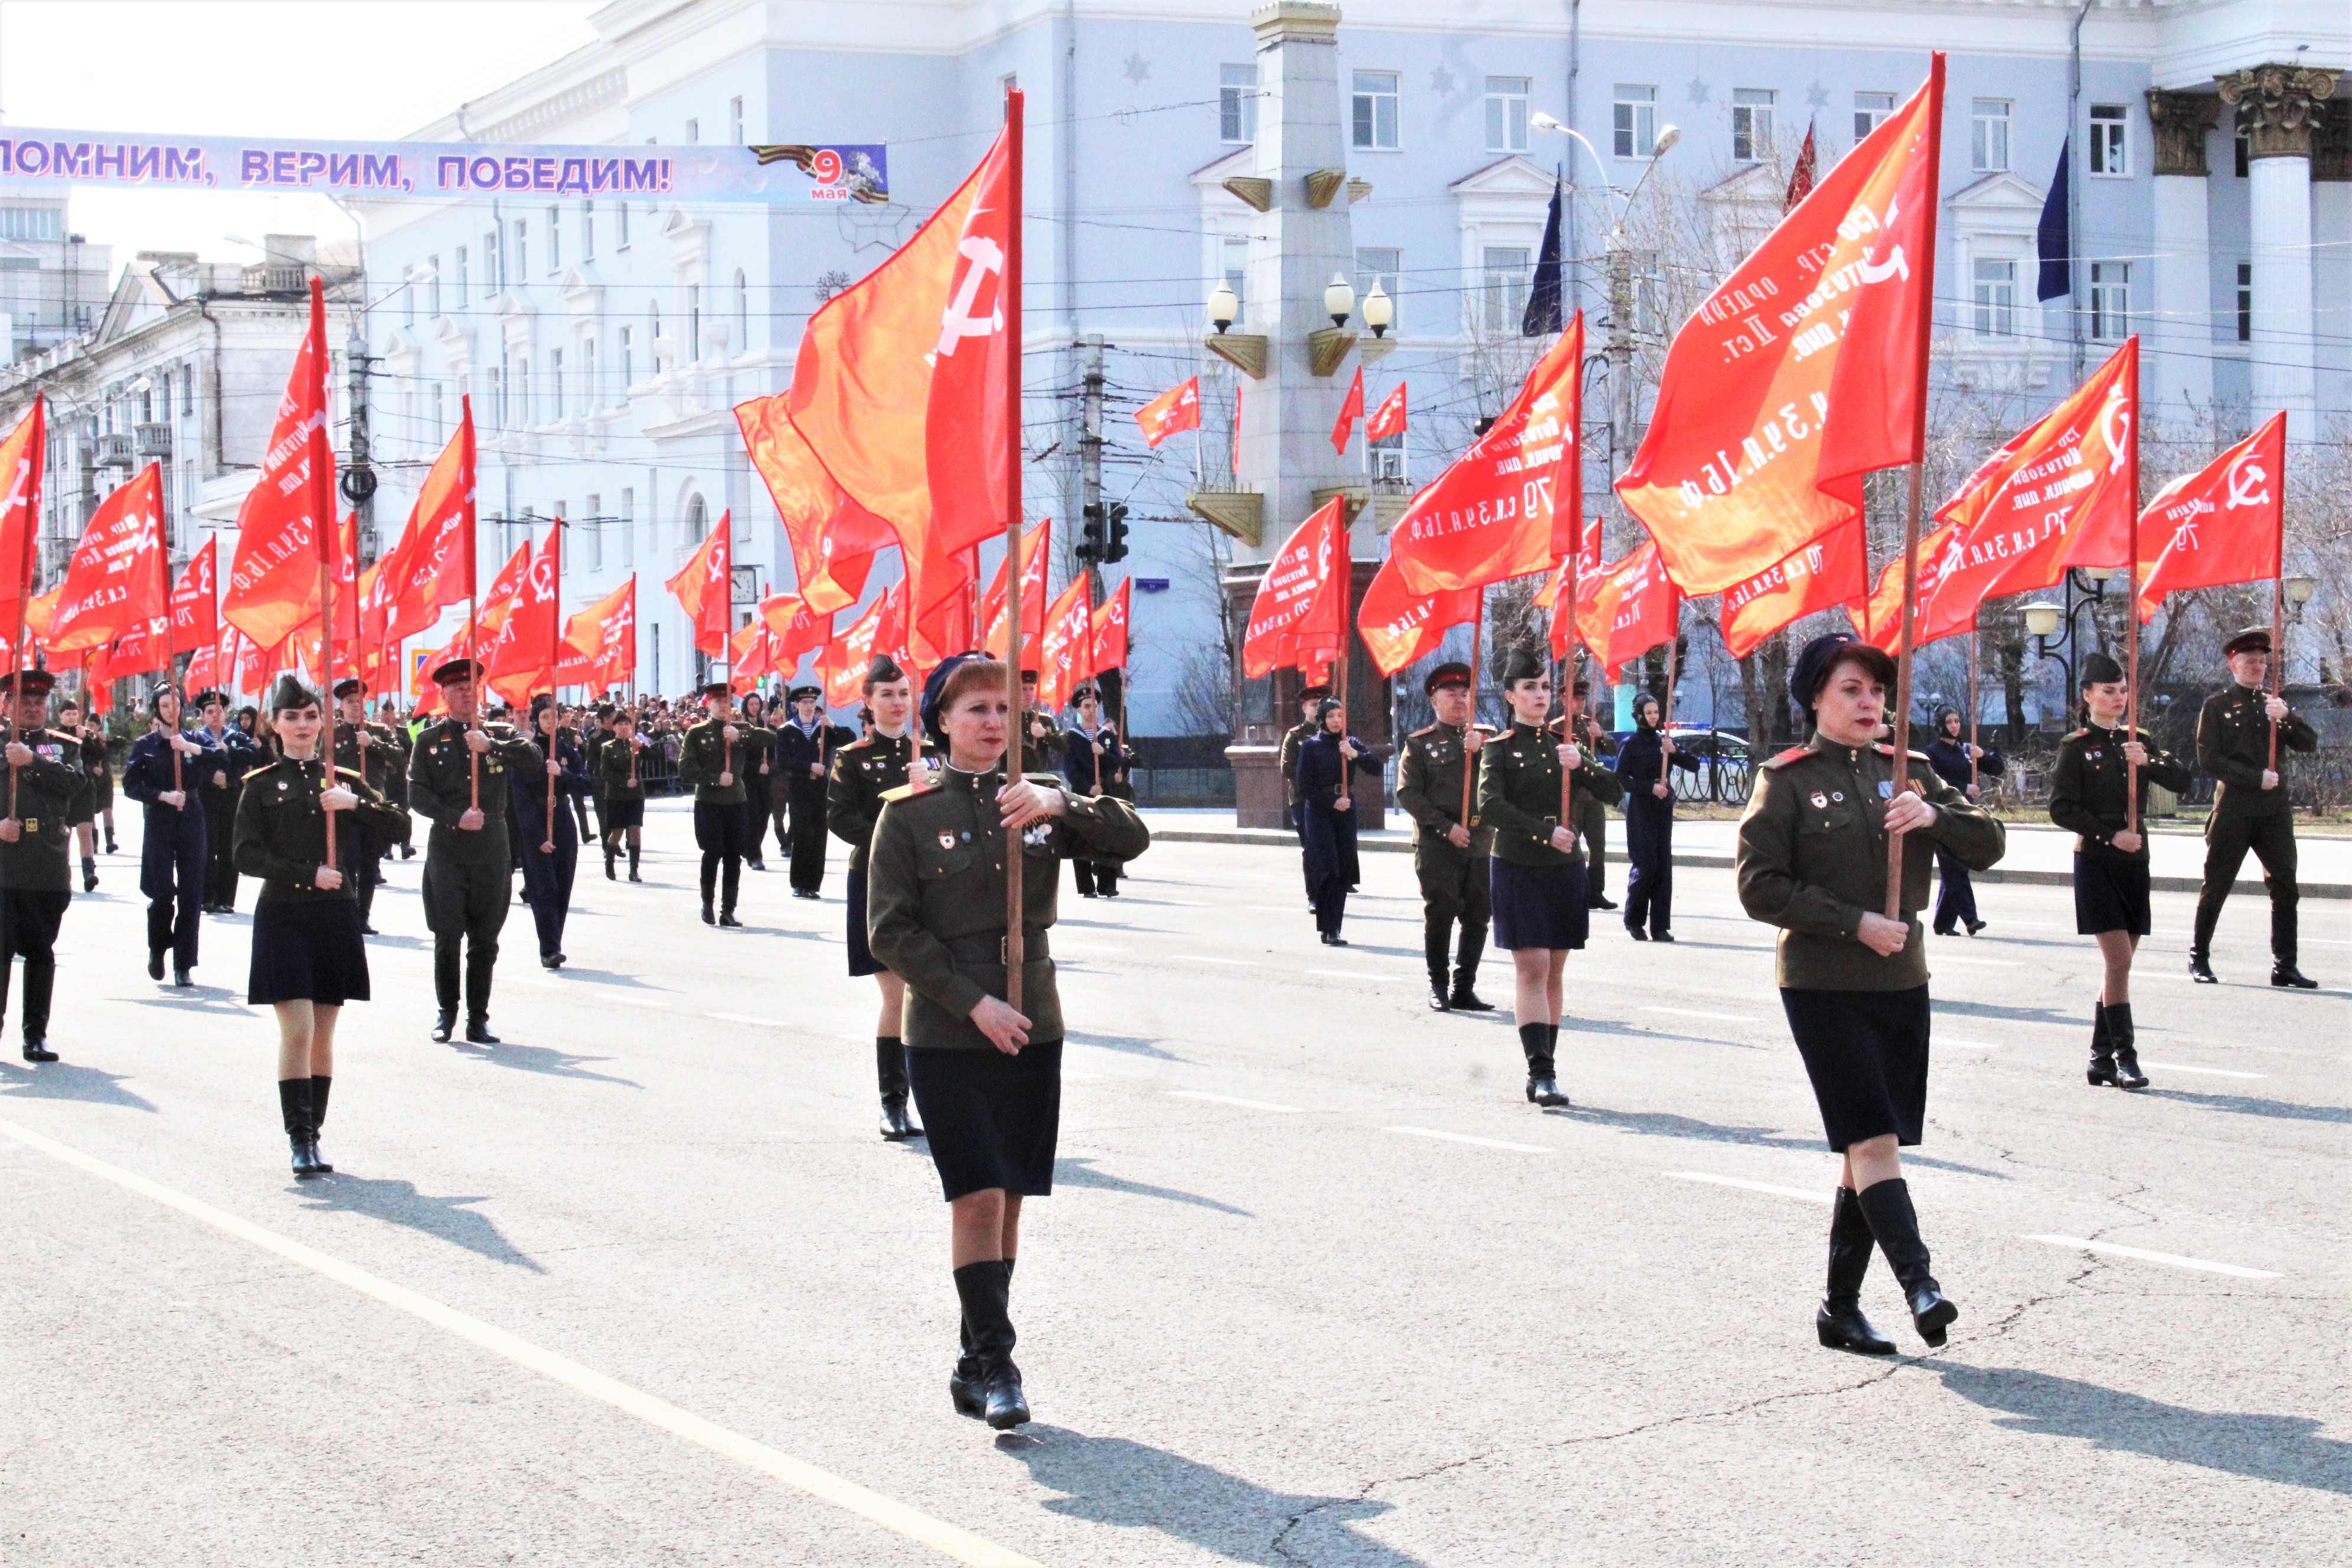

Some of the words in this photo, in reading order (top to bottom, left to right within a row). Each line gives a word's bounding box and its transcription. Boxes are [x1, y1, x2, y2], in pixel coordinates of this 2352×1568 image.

[241, 149, 414, 194] ВЕРИМ,
[437, 155, 672, 196] ПОБЕДИМ!
[814, 150, 842, 184] 9
[811, 189, 847, 200] мая
